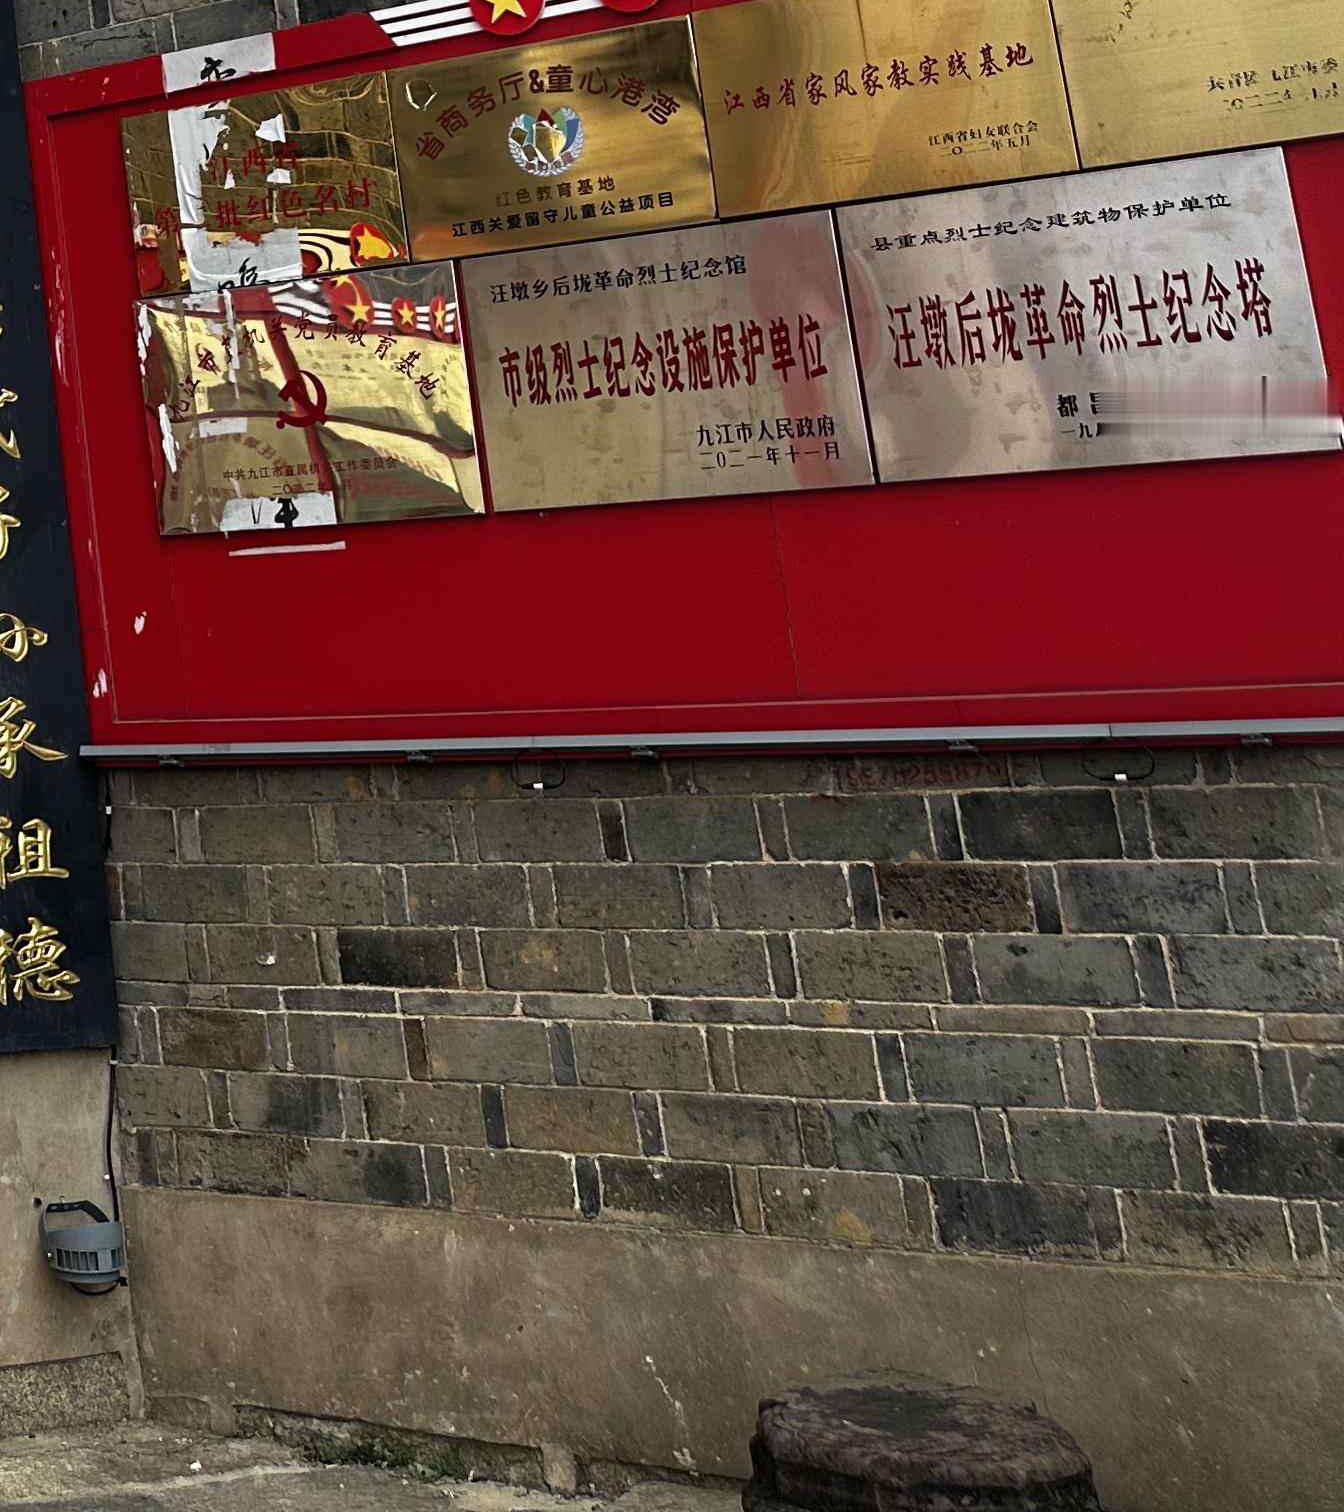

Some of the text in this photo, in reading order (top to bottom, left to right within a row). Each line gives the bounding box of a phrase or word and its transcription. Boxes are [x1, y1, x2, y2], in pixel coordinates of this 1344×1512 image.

[724, 42, 1033, 115] 江西省家风家教实践基地
[416, 64, 681, 161] 省商务厅&童心港湾
[928, 119, 1038, 147] 江西省妇女联合会
[155, 178, 376, 232] 第批红色名村
[452, 191, 674, 238] 江西关爱留守儿童公益项目
[495, 176, 616, 208] 红色教育基地
[870, 193, 1232, 252] 县重点烈士纪念建筑物保护单位
[499, 313, 828, 408] 市级烈士纪念设施保护单位
[697, 414, 836, 447] 九江市人民政府
